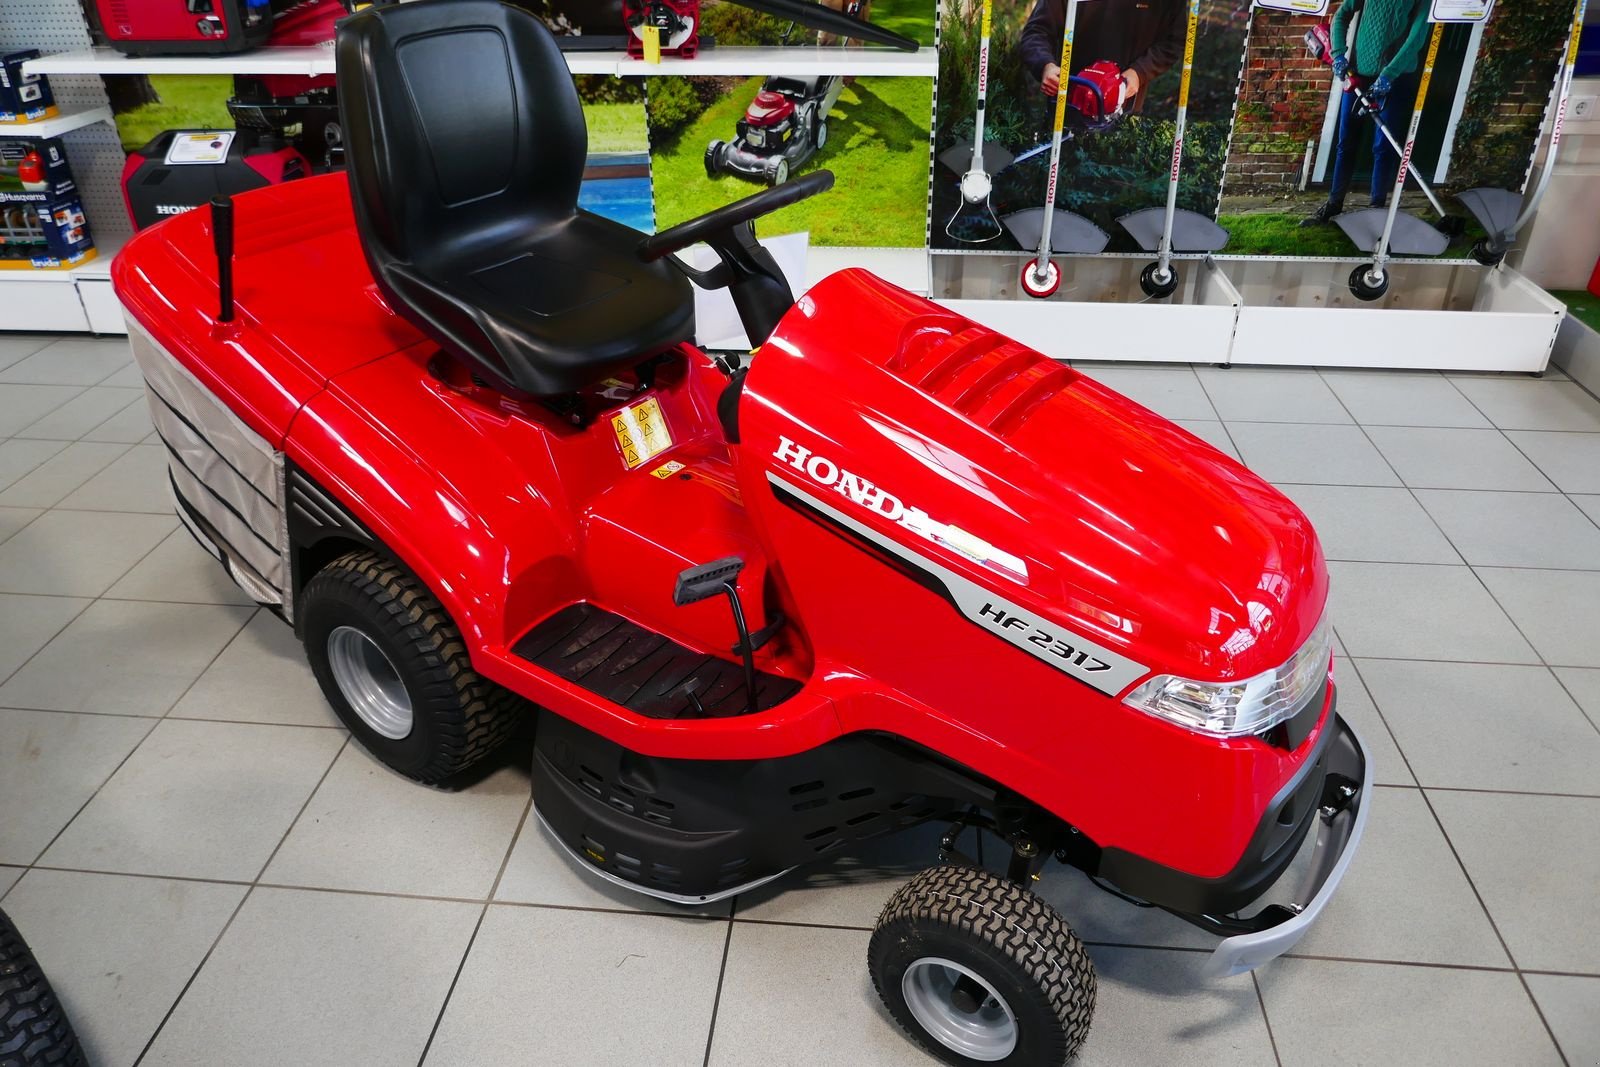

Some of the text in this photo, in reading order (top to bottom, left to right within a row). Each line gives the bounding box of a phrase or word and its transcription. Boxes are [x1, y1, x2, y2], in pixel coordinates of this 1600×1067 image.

[978, 47, 988, 92] HONDA
[1551, 97, 1568, 145] HONDA
[1171, 138, 1181, 181] HONDA
[1397, 140, 1414, 183] HONDA
[5, 193, 47, 202] Husqvarna
[1047, 161, 1058, 204] HONDA
[156, 205, 197, 214] HON
[772, 435, 943, 543] HONDA
[979, 602, 1113, 672] HF 2317
